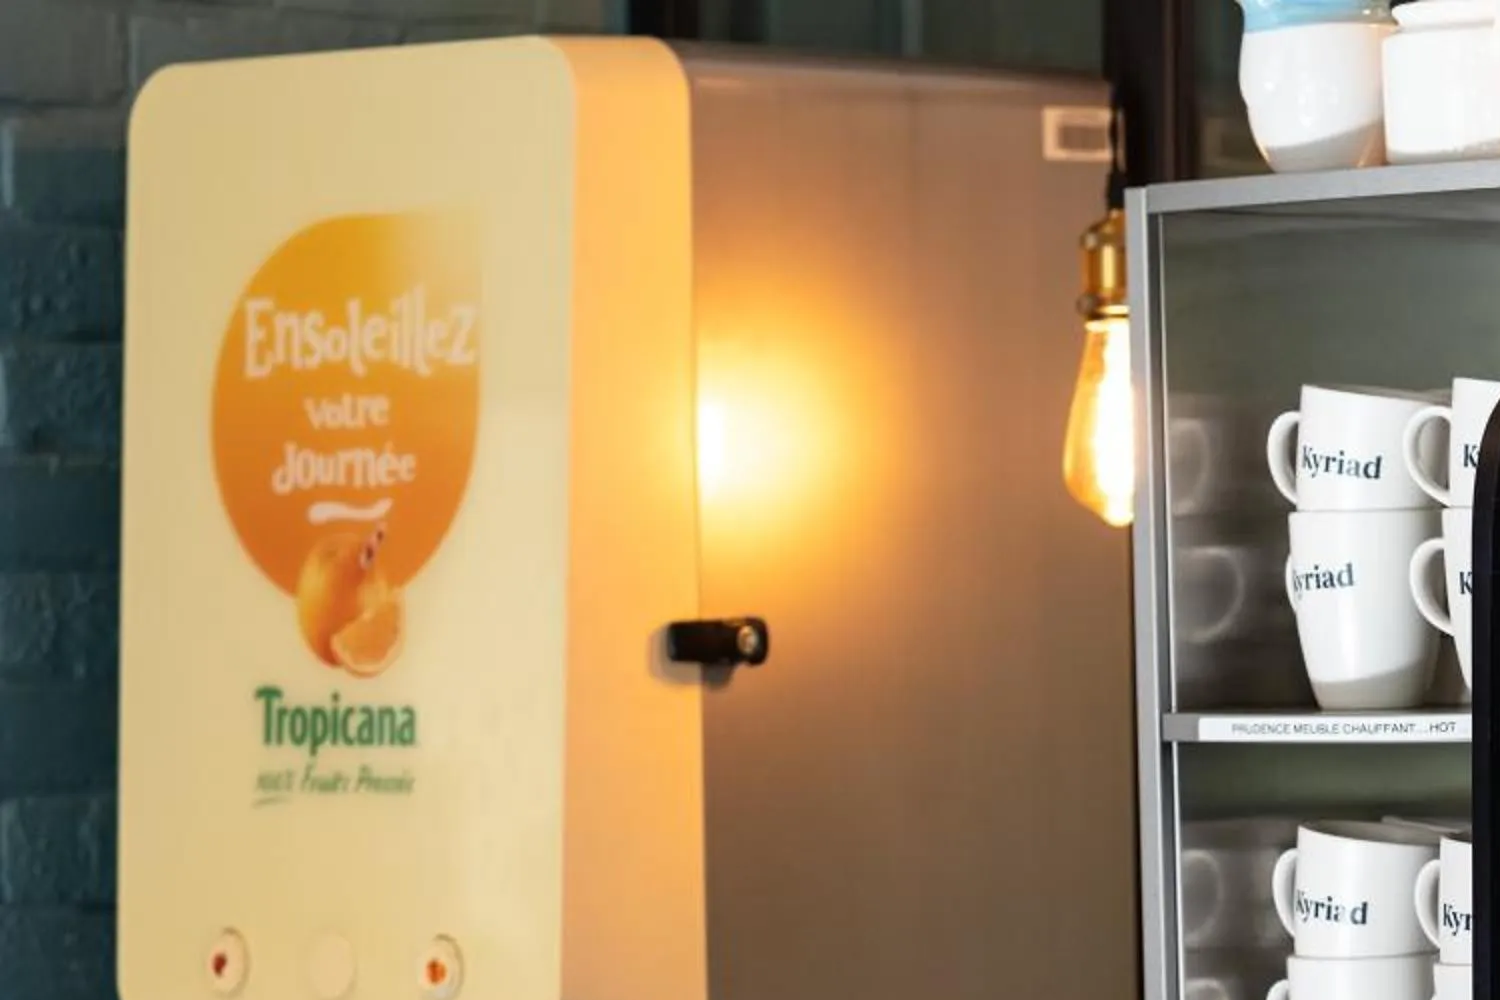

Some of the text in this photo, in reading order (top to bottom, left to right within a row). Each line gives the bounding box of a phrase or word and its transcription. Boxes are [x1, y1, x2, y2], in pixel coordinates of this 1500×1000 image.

[245, 284, 477, 379] Ensoleillez
[1302, 445, 1382, 480] Kyriad
[255, 686, 416, 757] Tropicana
[1443, 903, 1473, 937] Kyr
